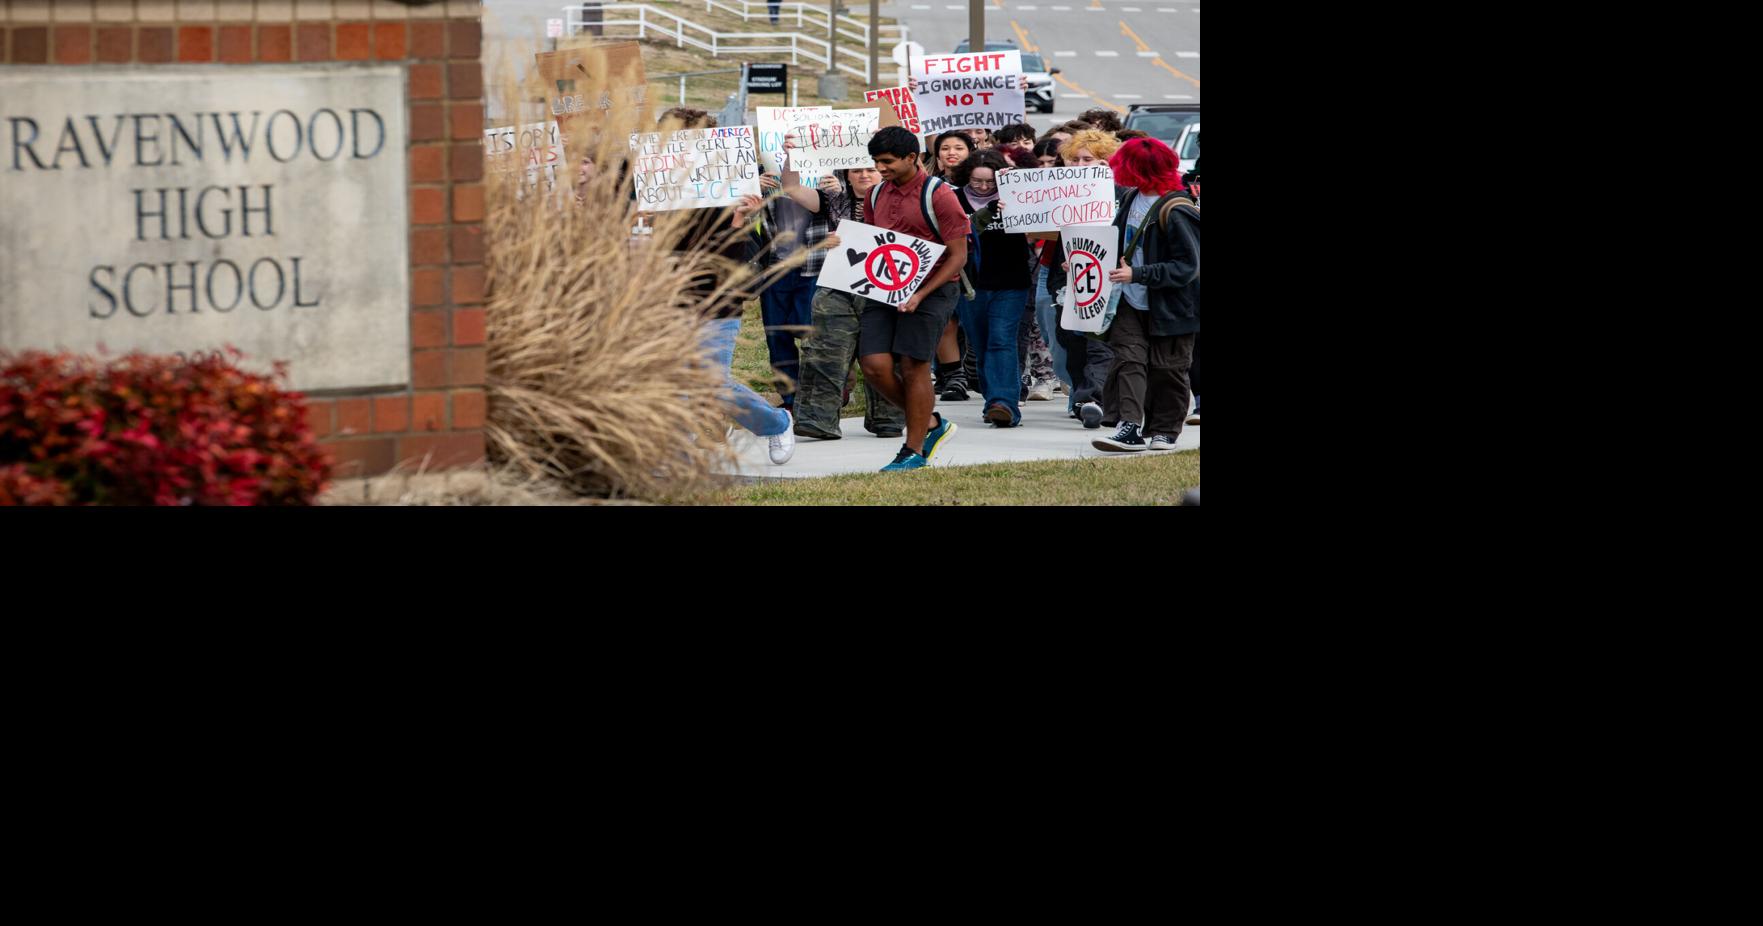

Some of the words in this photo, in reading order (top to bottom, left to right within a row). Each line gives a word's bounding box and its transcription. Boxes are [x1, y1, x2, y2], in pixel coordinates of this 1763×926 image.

[924, 54, 1005, 75] FIGHT
[918, 75, 1015, 95] IGNORANCE
[945, 92, 994, 107] NOT
[711, 127, 750, 138] AMERICA
[921, 112, 1023, 134] IMMIGRANTS
[8, 108, 385, 171] RAVENWOOD
[696, 139, 729, 150] GIRL
[734, 137, 752, 149] IS
[705, 151, 728, 165] IN
[736, 149, 756, 163] AN
[795, 159, 812, 168] NO
[689, 164, 754, 182] WRITING
[998, 172, 1020, 185] IT'S
[1024, 170, 1044, 182] NOT
[1048, 167, 1088, 180] ABOUT
[1091, 166, 1112, 179] THE
[638, 185, 683, 204] ABOUT
[693, 181, 739, 199] ICE
[132, 184, 275, 241] HIGH
[1051, 201, 1114, 224] CONTROL
[874, 232, 896, 246] NO
[1072, 237, 1107, 261] HUMAN
[876, 246, 911, 280] ICE
[88, 257, 319, 319] SCHOOL
[850, 278, 875, 295] IS
[886, 274, 926, 304] ILLEGAL
